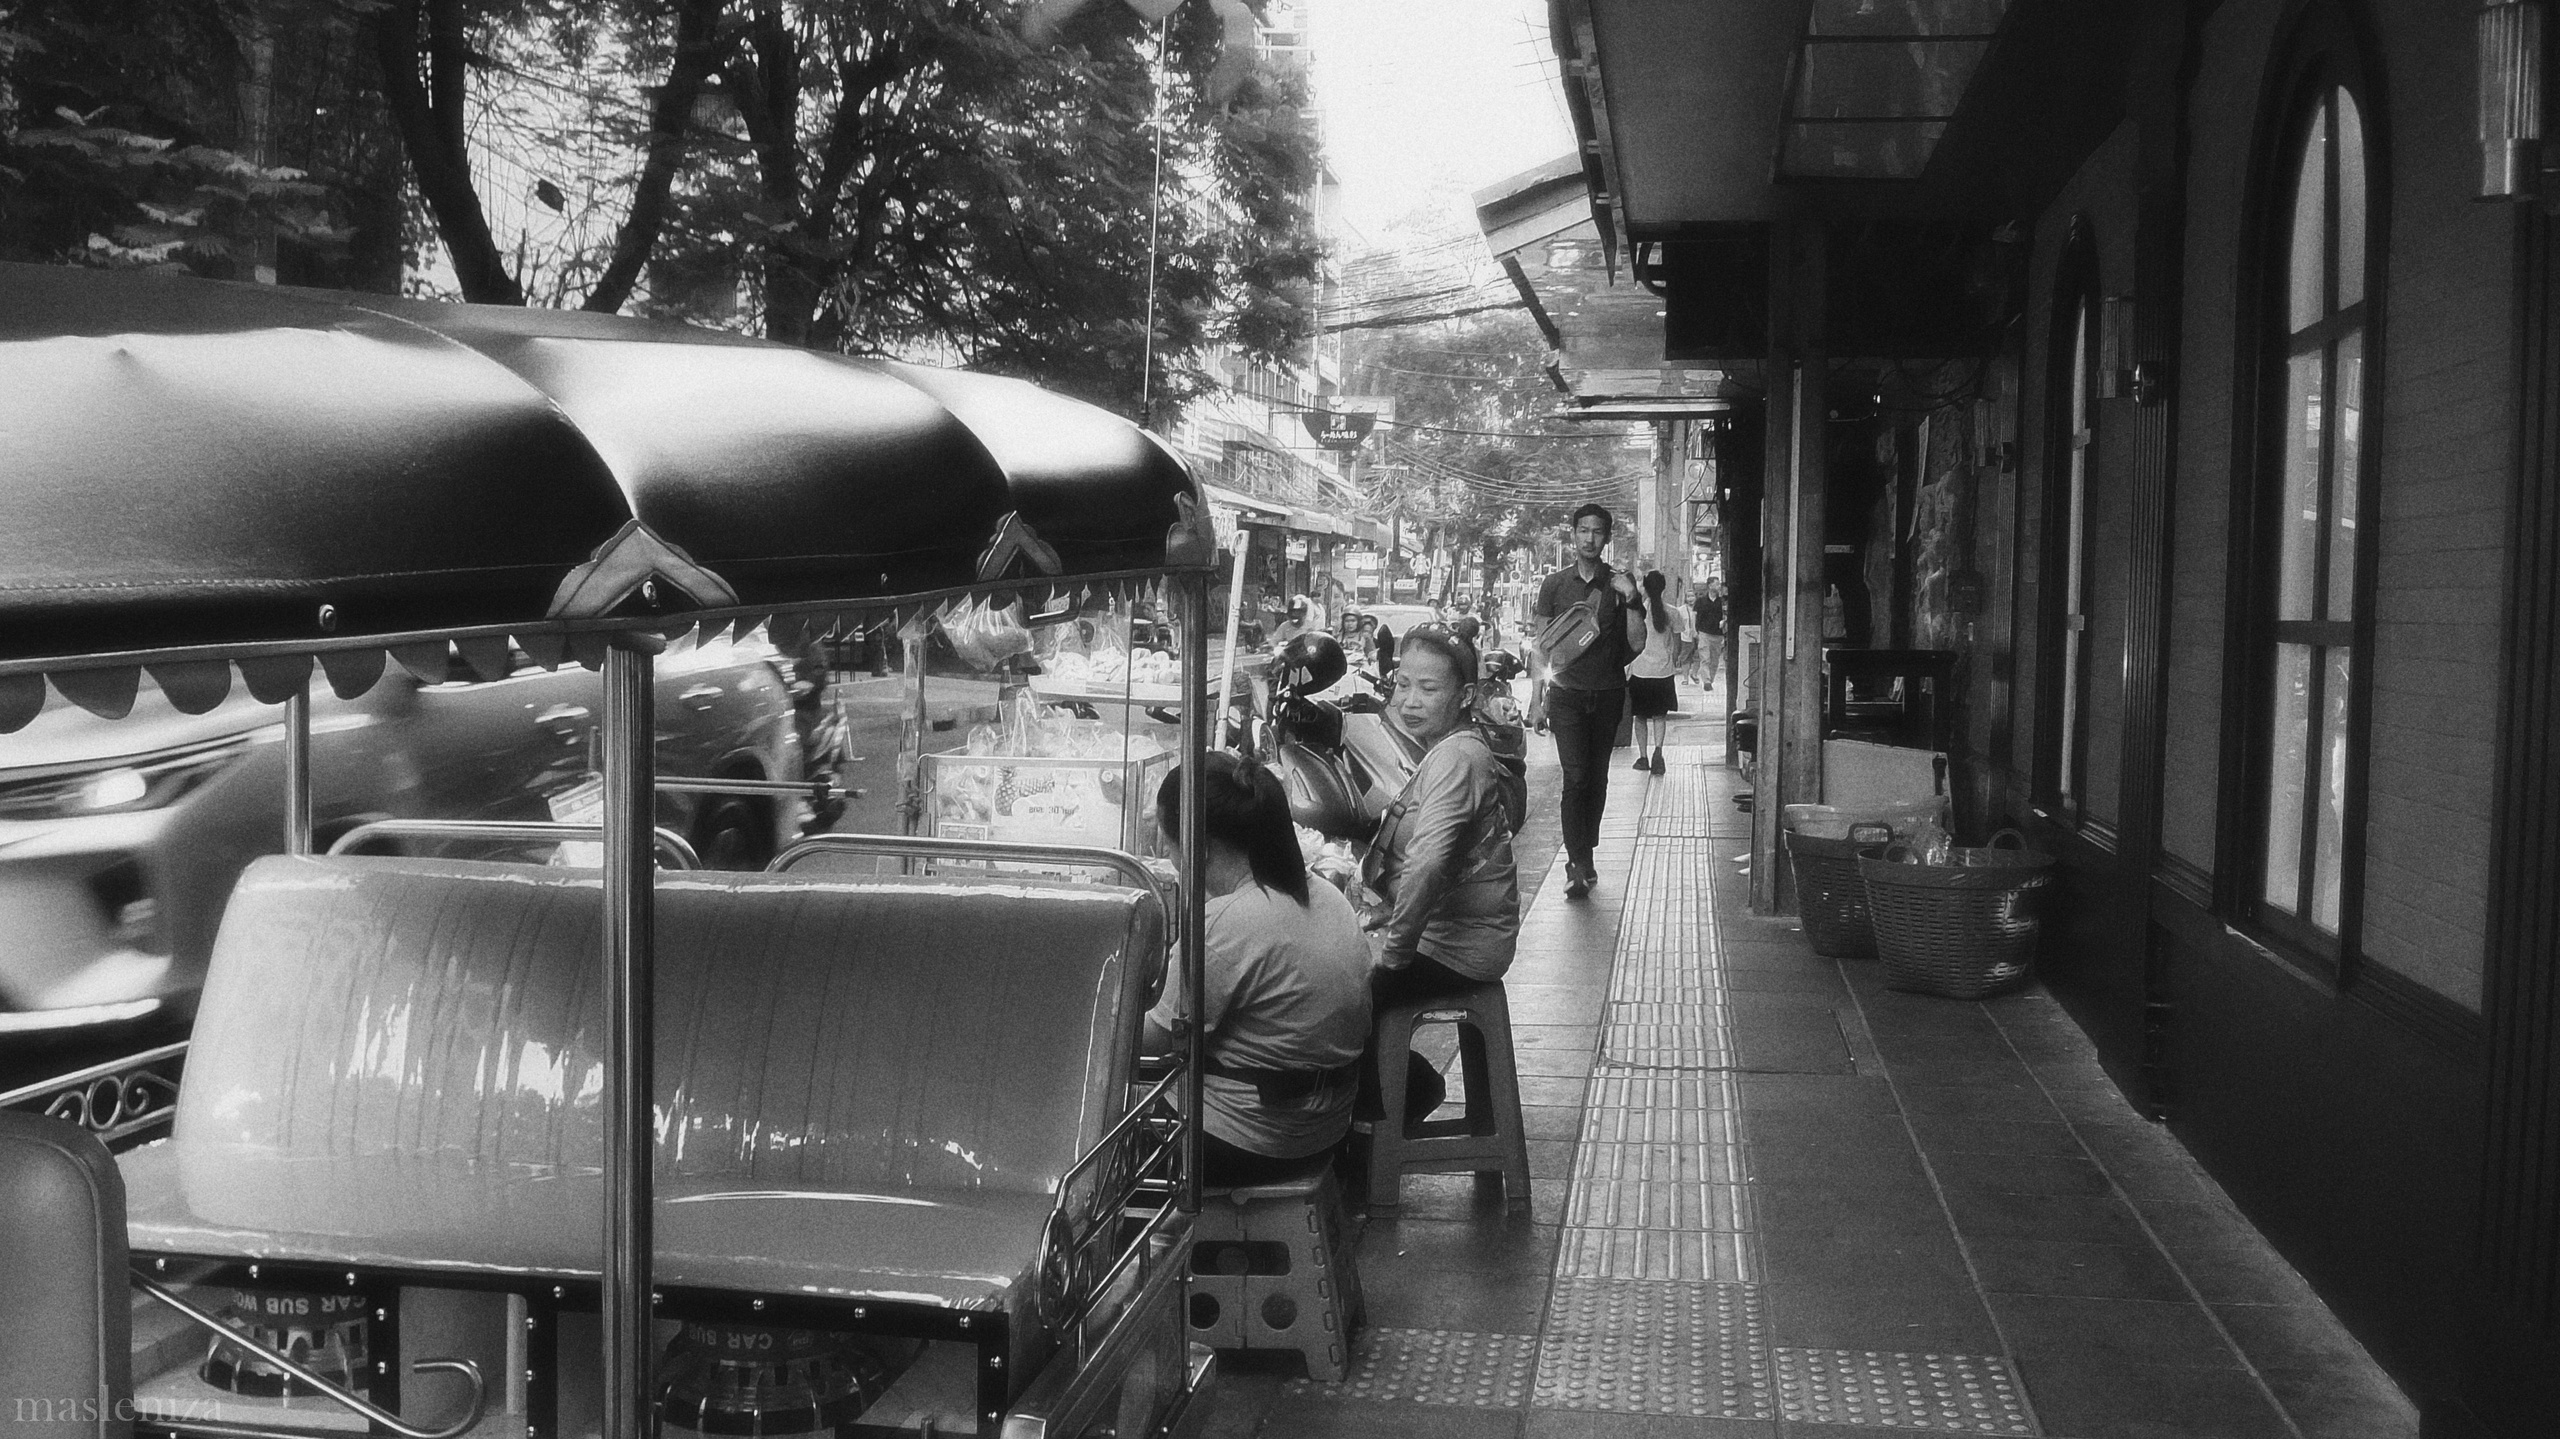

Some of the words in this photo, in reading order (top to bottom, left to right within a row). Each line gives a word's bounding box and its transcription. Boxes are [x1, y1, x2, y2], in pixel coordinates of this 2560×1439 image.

[266, 1298, 309, 1315] SUB
[321, 1296, 366, 1313] CAR
[728, 1333, 773, 1350] CAR
